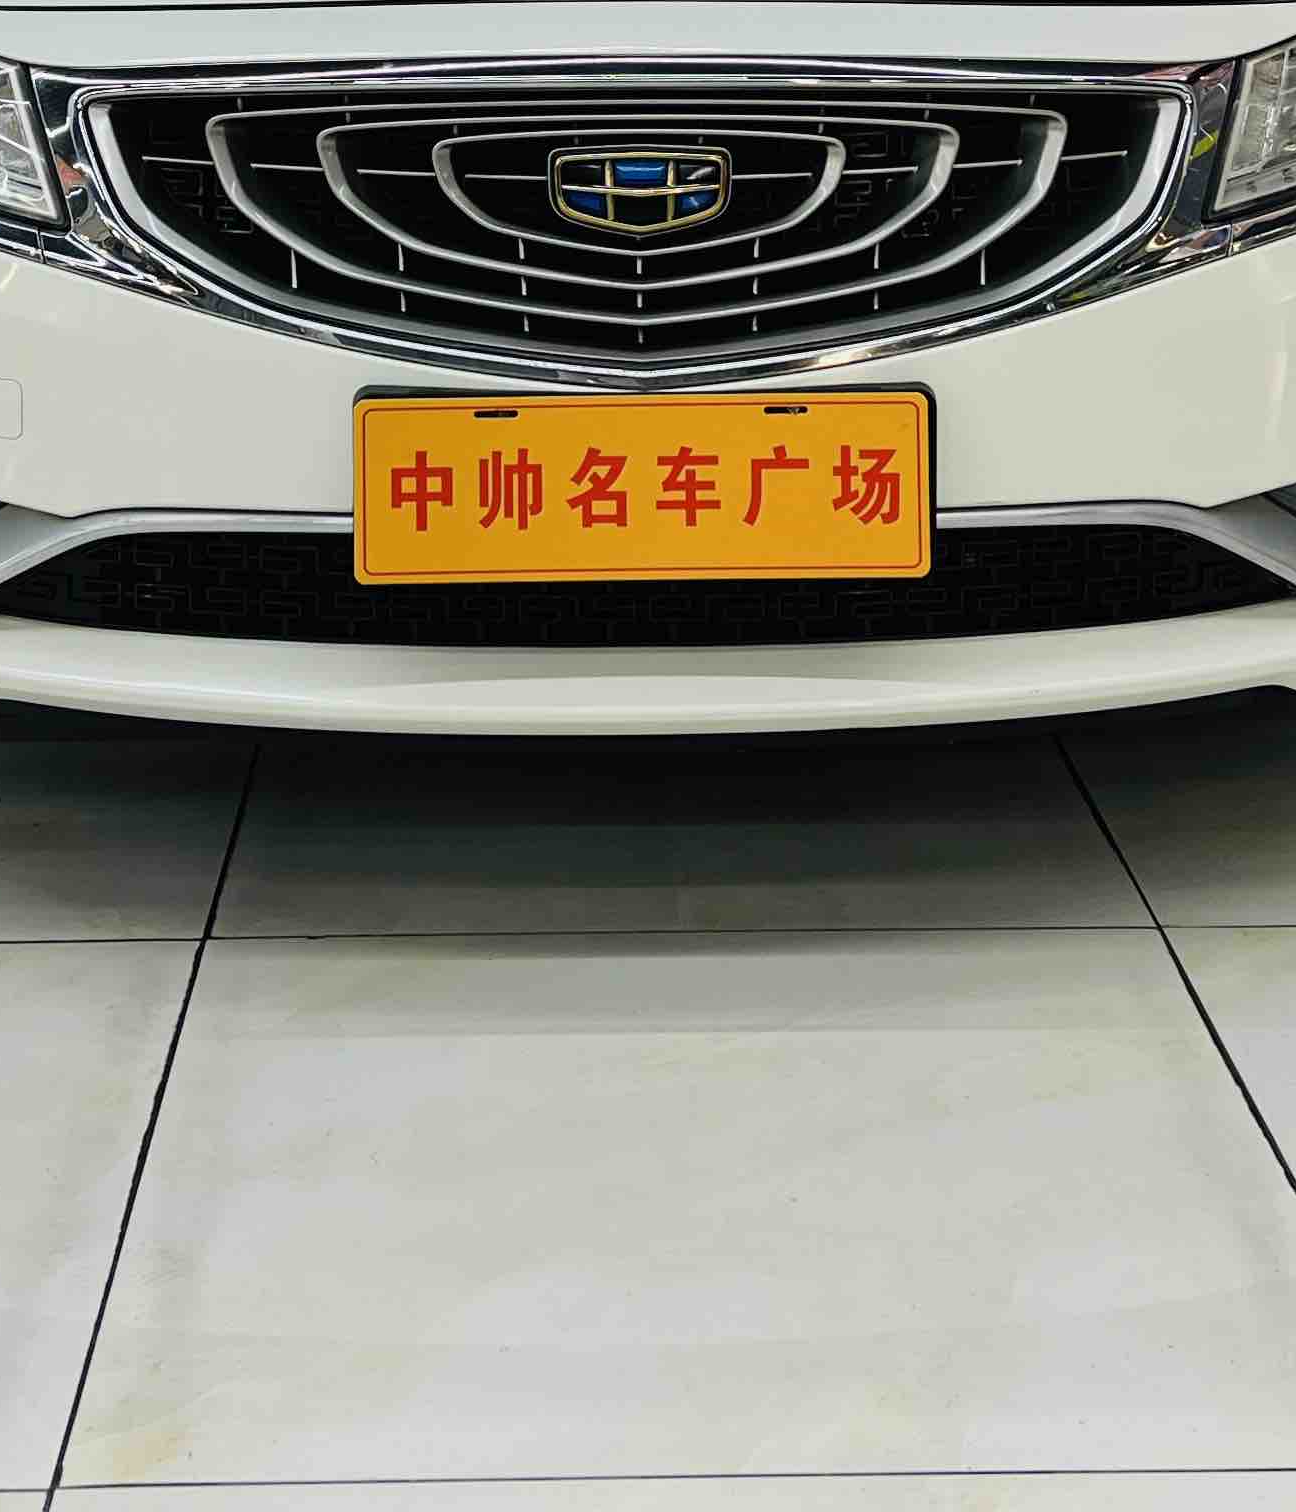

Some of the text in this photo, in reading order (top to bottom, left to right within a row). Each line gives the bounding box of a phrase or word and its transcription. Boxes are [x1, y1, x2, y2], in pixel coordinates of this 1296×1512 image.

[390, 445, 901, 532] 中帅名车广场
